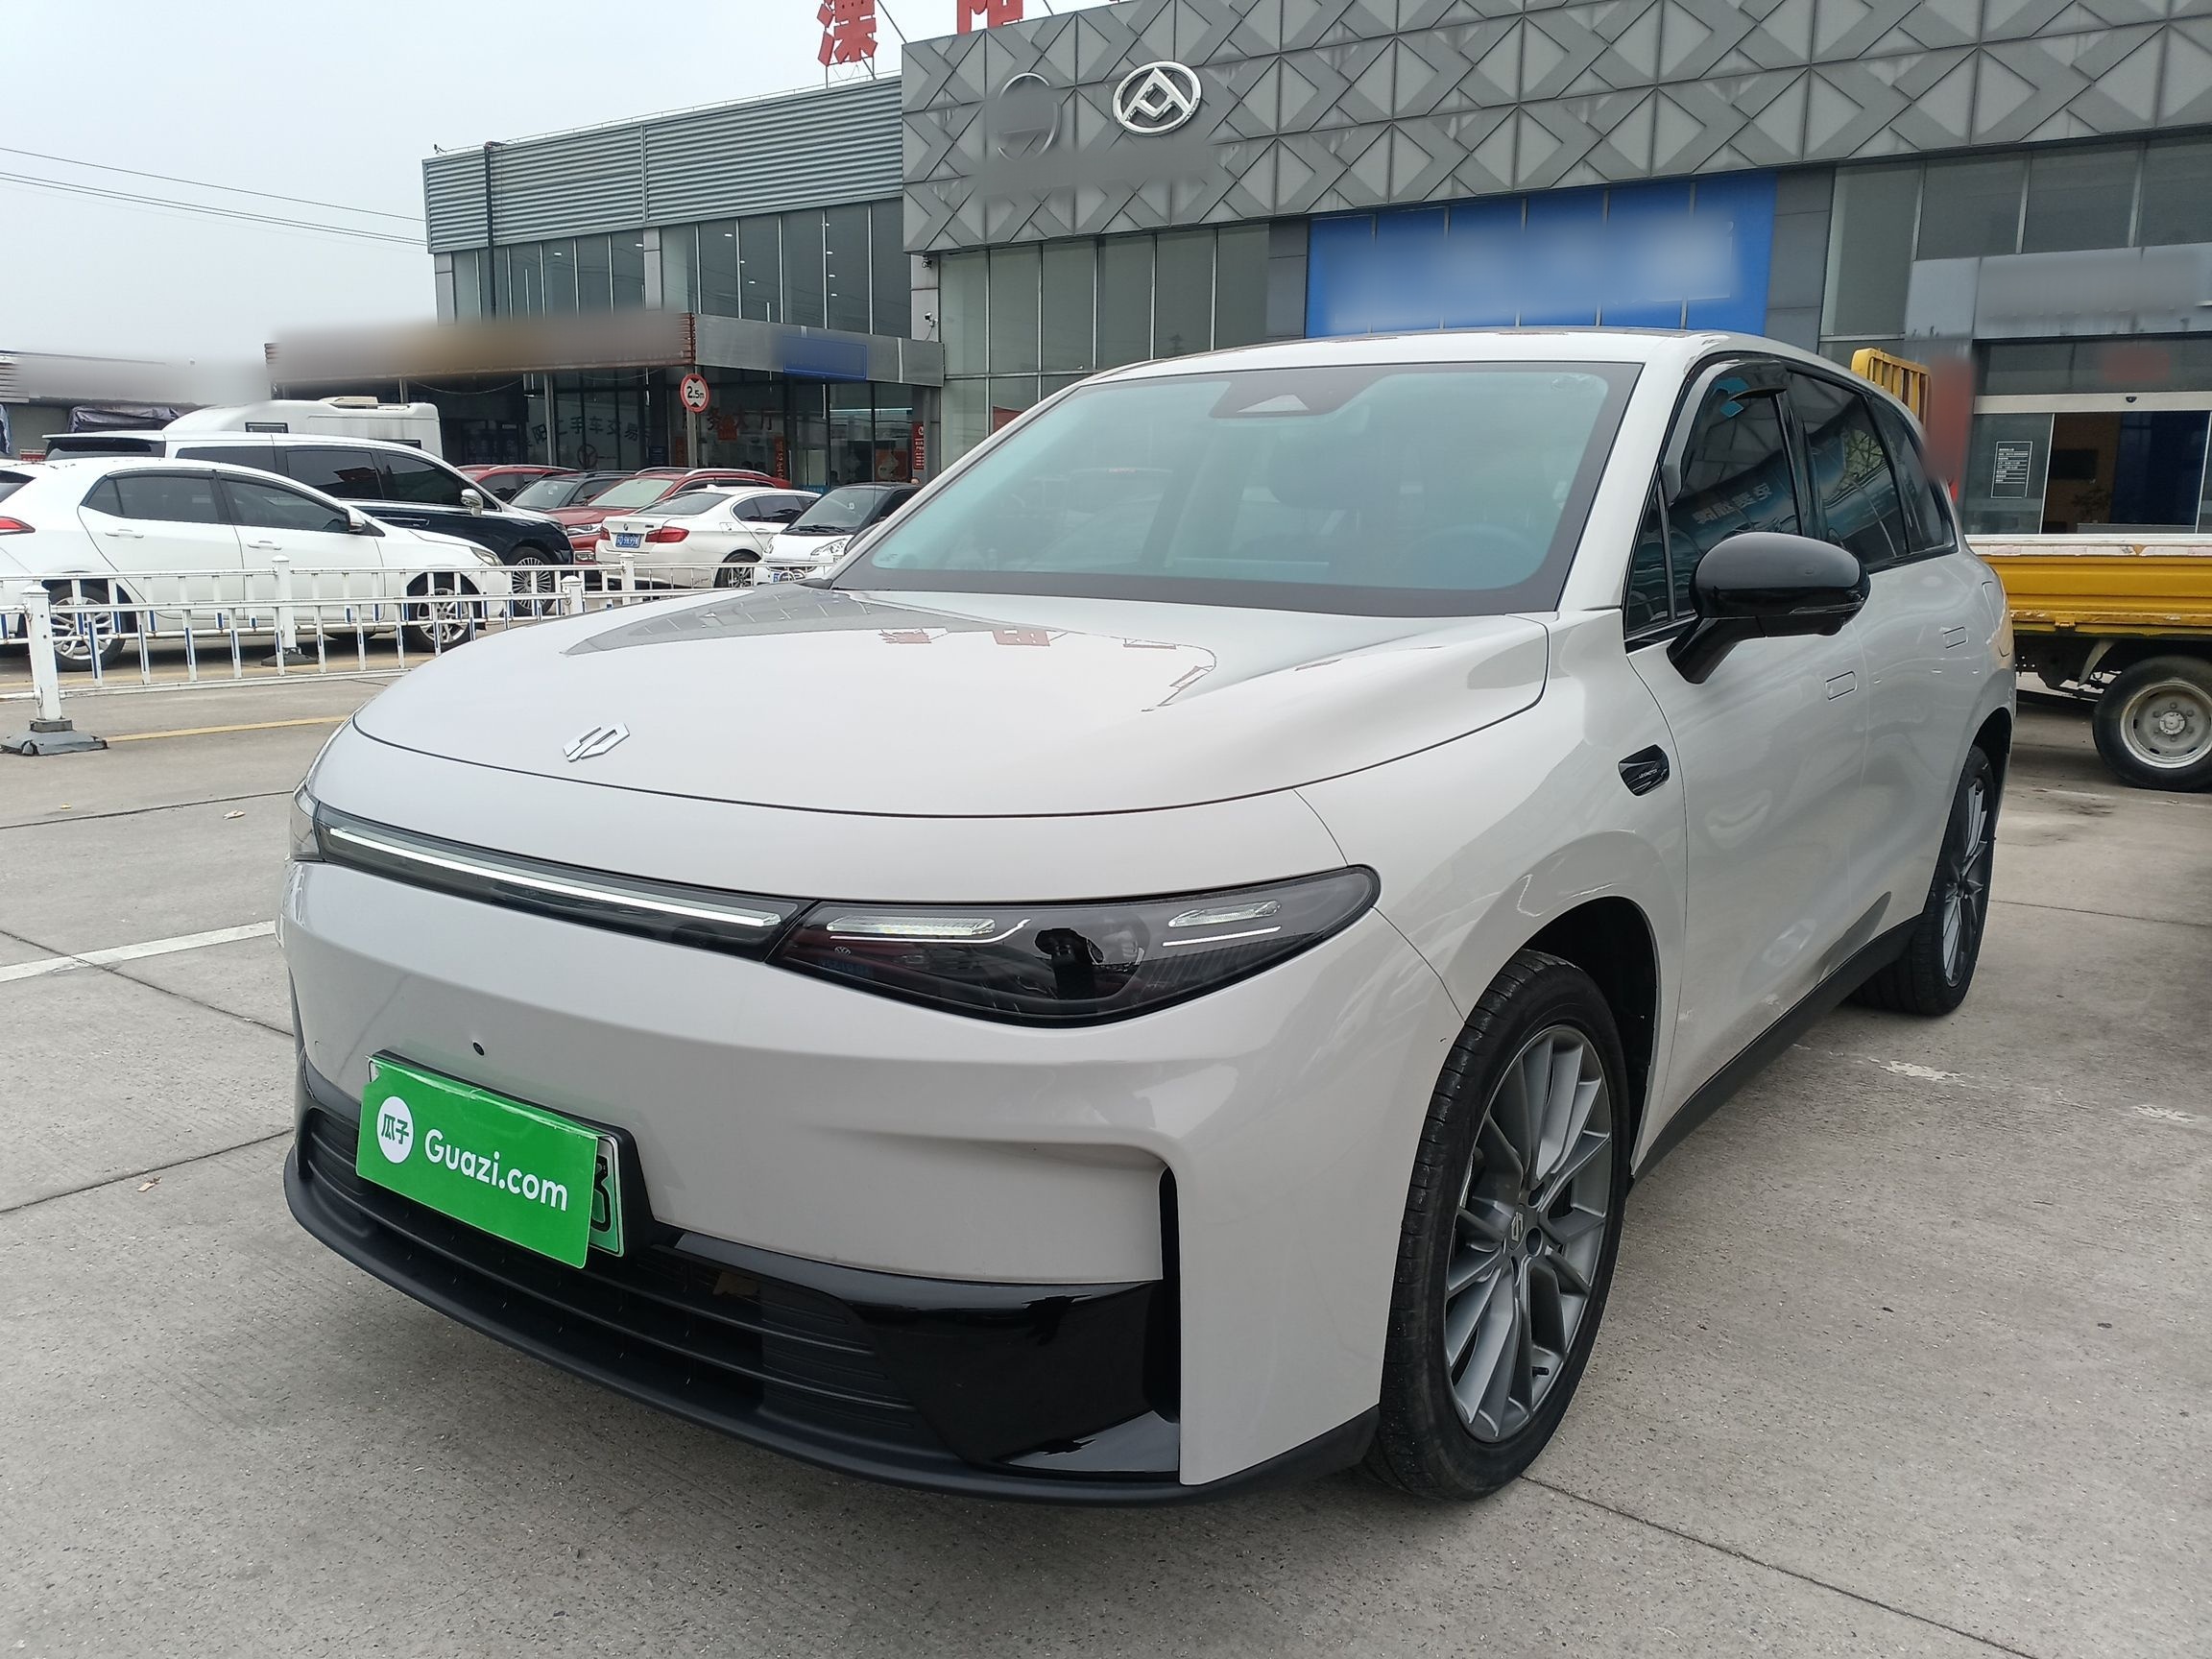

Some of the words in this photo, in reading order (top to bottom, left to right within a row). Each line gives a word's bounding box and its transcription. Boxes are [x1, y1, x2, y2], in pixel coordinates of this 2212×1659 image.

[686, 385, 706, 399] 2.5m
[380, 1113, 410, 1145] 瓜子
[424, 1128, 568, 1212] Guazi.com
